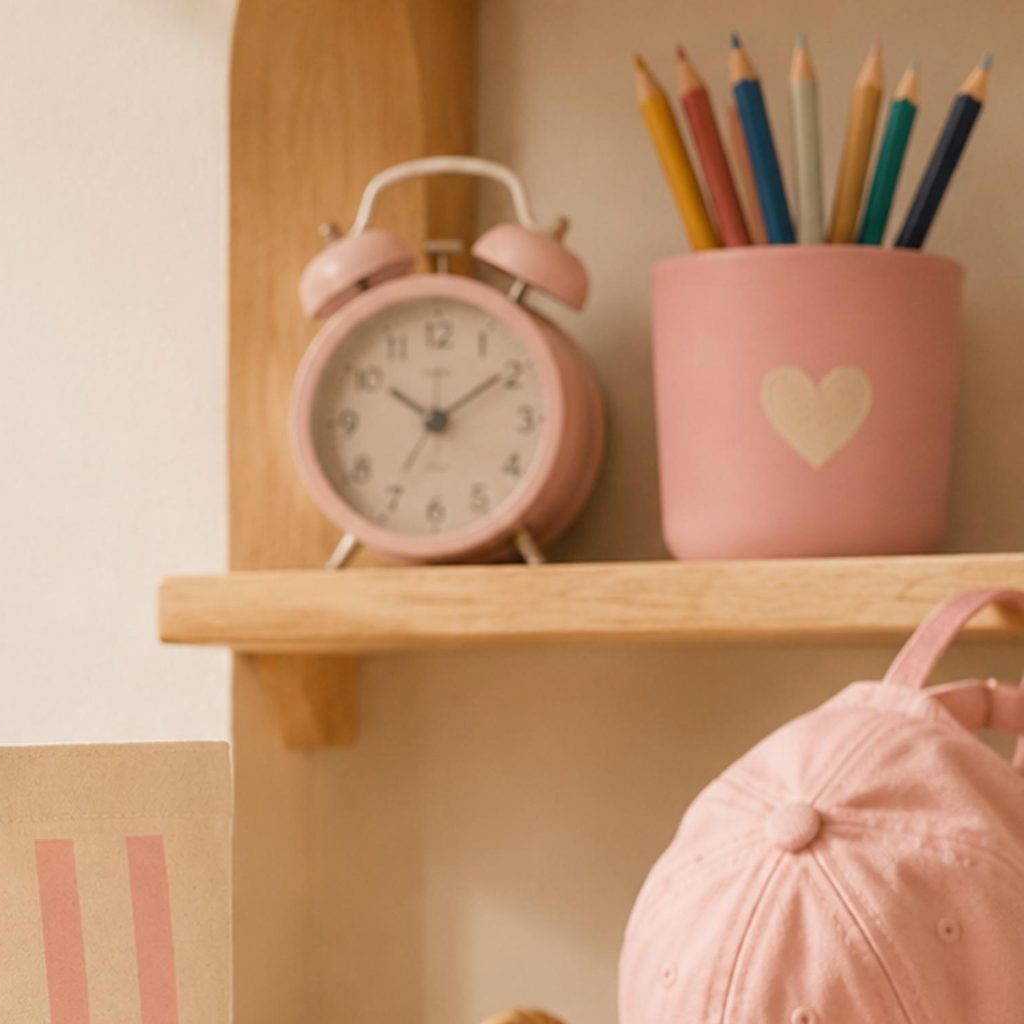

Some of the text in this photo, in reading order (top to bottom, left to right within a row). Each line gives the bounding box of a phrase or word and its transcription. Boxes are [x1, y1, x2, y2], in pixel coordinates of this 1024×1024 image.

[387, 334, 408, 361] 11
[427, 320, 453, 349] 12
[477, 331, 487, 357] 1
[355, 366, 382, 391] 10
[503, 361, 522, 389] 2
[339, 409, 359, 436] 9
[517, 405, 534, 434] 3
[351, 455, 372, 483] 8
[502, 453, 520, 478] 4
[385, 485, 404, 511] 7
[426, 498, 446, 524] 6
[471, 484, 489, 512] 5
